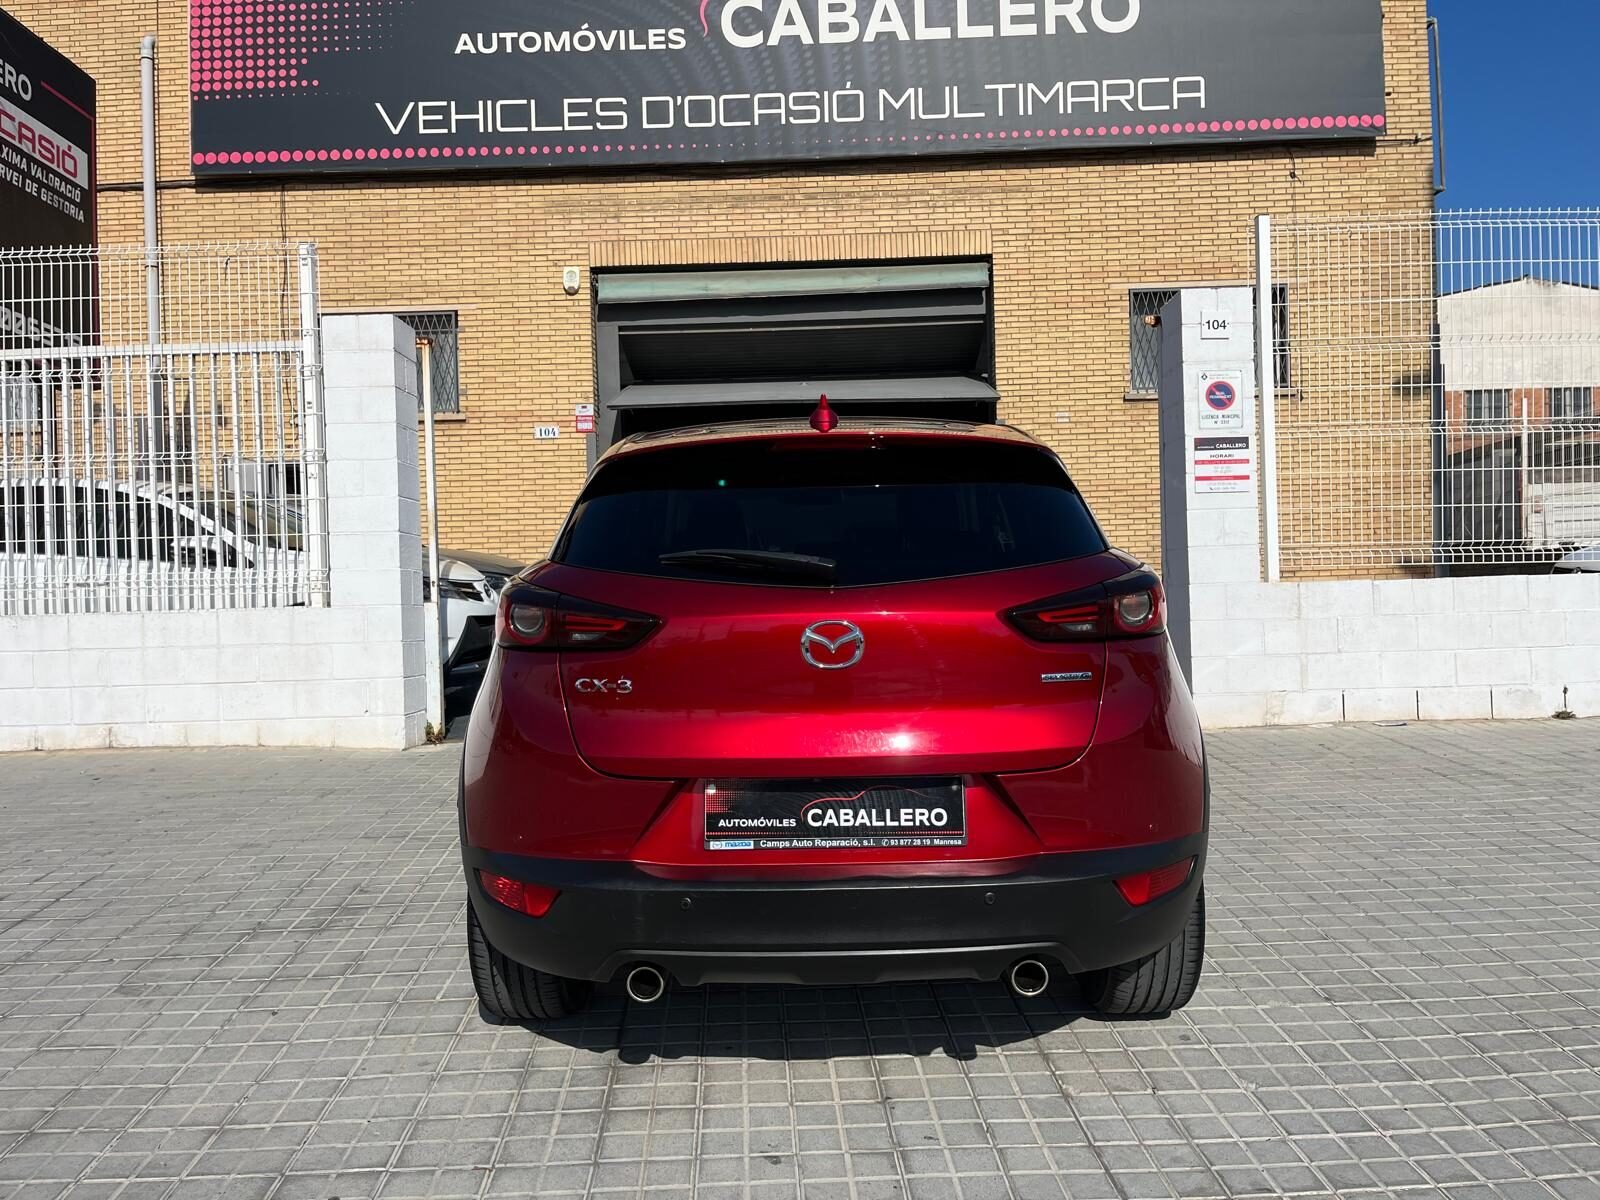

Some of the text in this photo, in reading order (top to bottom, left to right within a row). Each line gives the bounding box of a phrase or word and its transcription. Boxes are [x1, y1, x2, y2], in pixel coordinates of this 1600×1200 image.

[454, 0, 1141, 54] AUTOMÓVILES CABALLERO
[375, 76, 1206, 134] VEHICLES D'OCASIÓ MULTIMARCA
[30, 162, 81, 203] VALORACIÓ
[25, 179, 38, 197] DE
[40, 187, 85, 223] GESTORIA
[1205, 319, 1227, 330] 104
[539, 427, 556, 437] 104
[574, 678, 632, 694] CX-3
[718, 807, 948, 828] AUTOMÓVILES CABALLERO
[759, 840, 790, 849] Camps
[792, 839, 813, 848] Auto
[933, 838, 962, 846] Manresa
